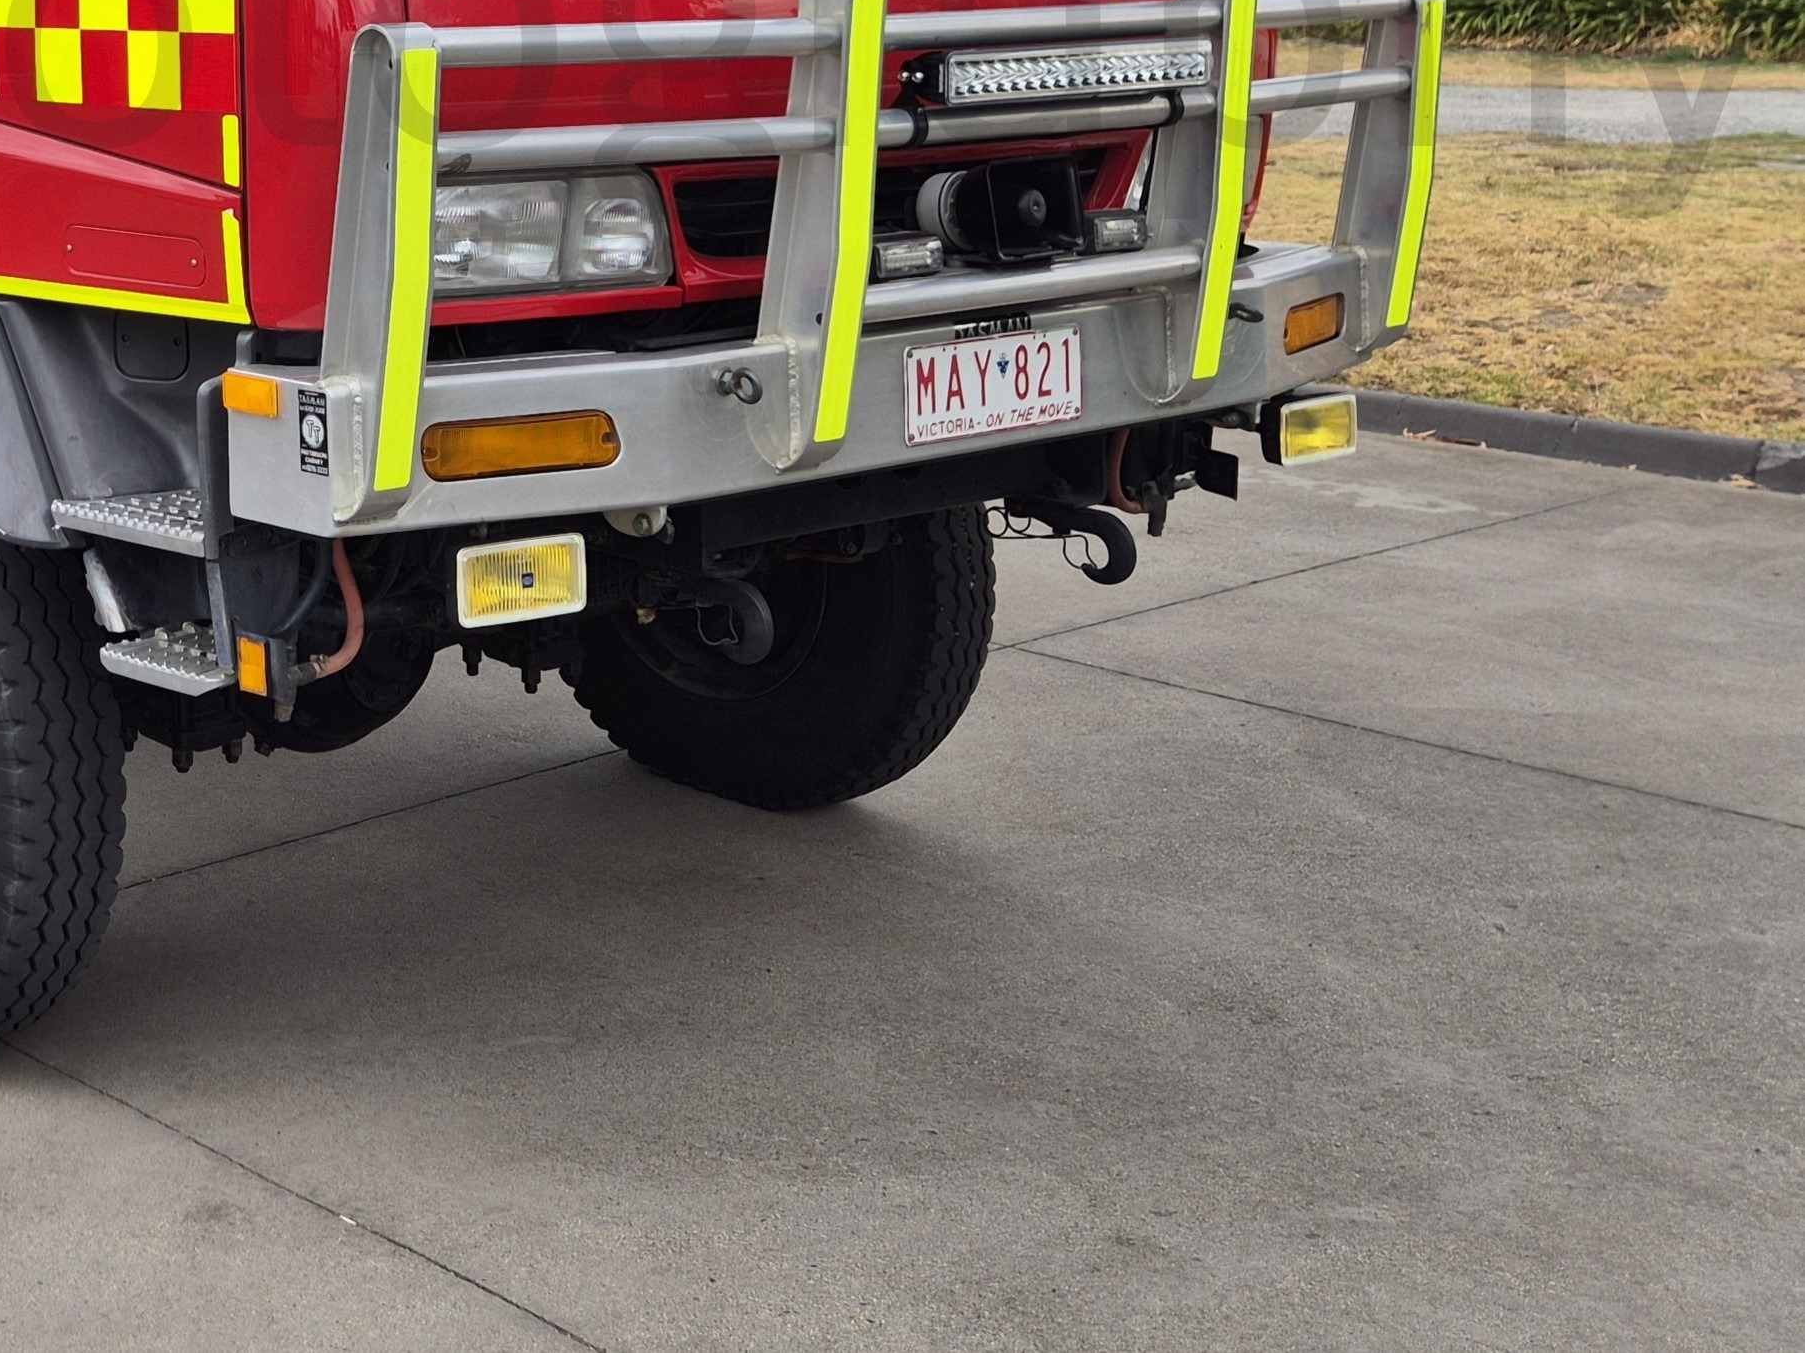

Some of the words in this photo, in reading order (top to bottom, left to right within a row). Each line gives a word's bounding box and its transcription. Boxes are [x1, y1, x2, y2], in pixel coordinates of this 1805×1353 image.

[916, 349, 992, 416] MAY
[1014, 338, 1070, 401] 821
[986, 412, 1005, 428] ON
[1010, 406, 1035, 424] THE
[1037, 400, 1074, 419] MOVE
